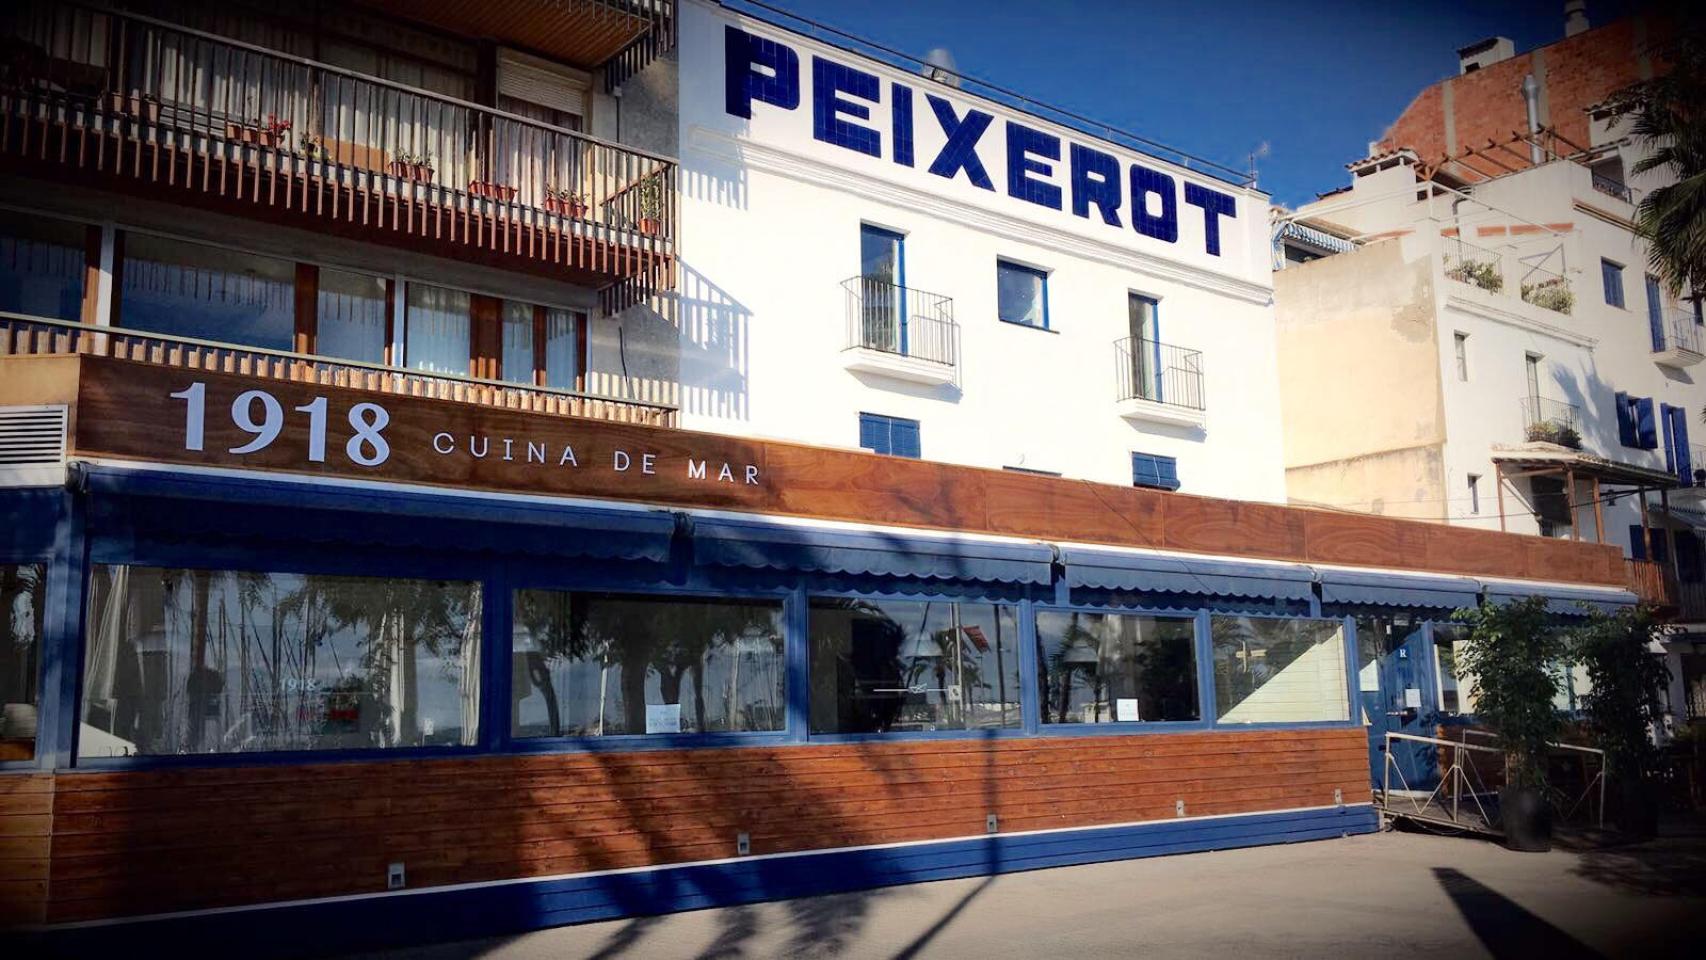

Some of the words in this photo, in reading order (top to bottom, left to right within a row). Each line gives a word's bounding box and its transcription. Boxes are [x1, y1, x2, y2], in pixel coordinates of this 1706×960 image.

[724, 24, 1236, 257] PEIXEROT
[170, 382, 391, 467] 1918
[433, 432, 578, 467] CUINA
[614, 450, 656, 475] DE
[688, 458, 759, 485] MAR
